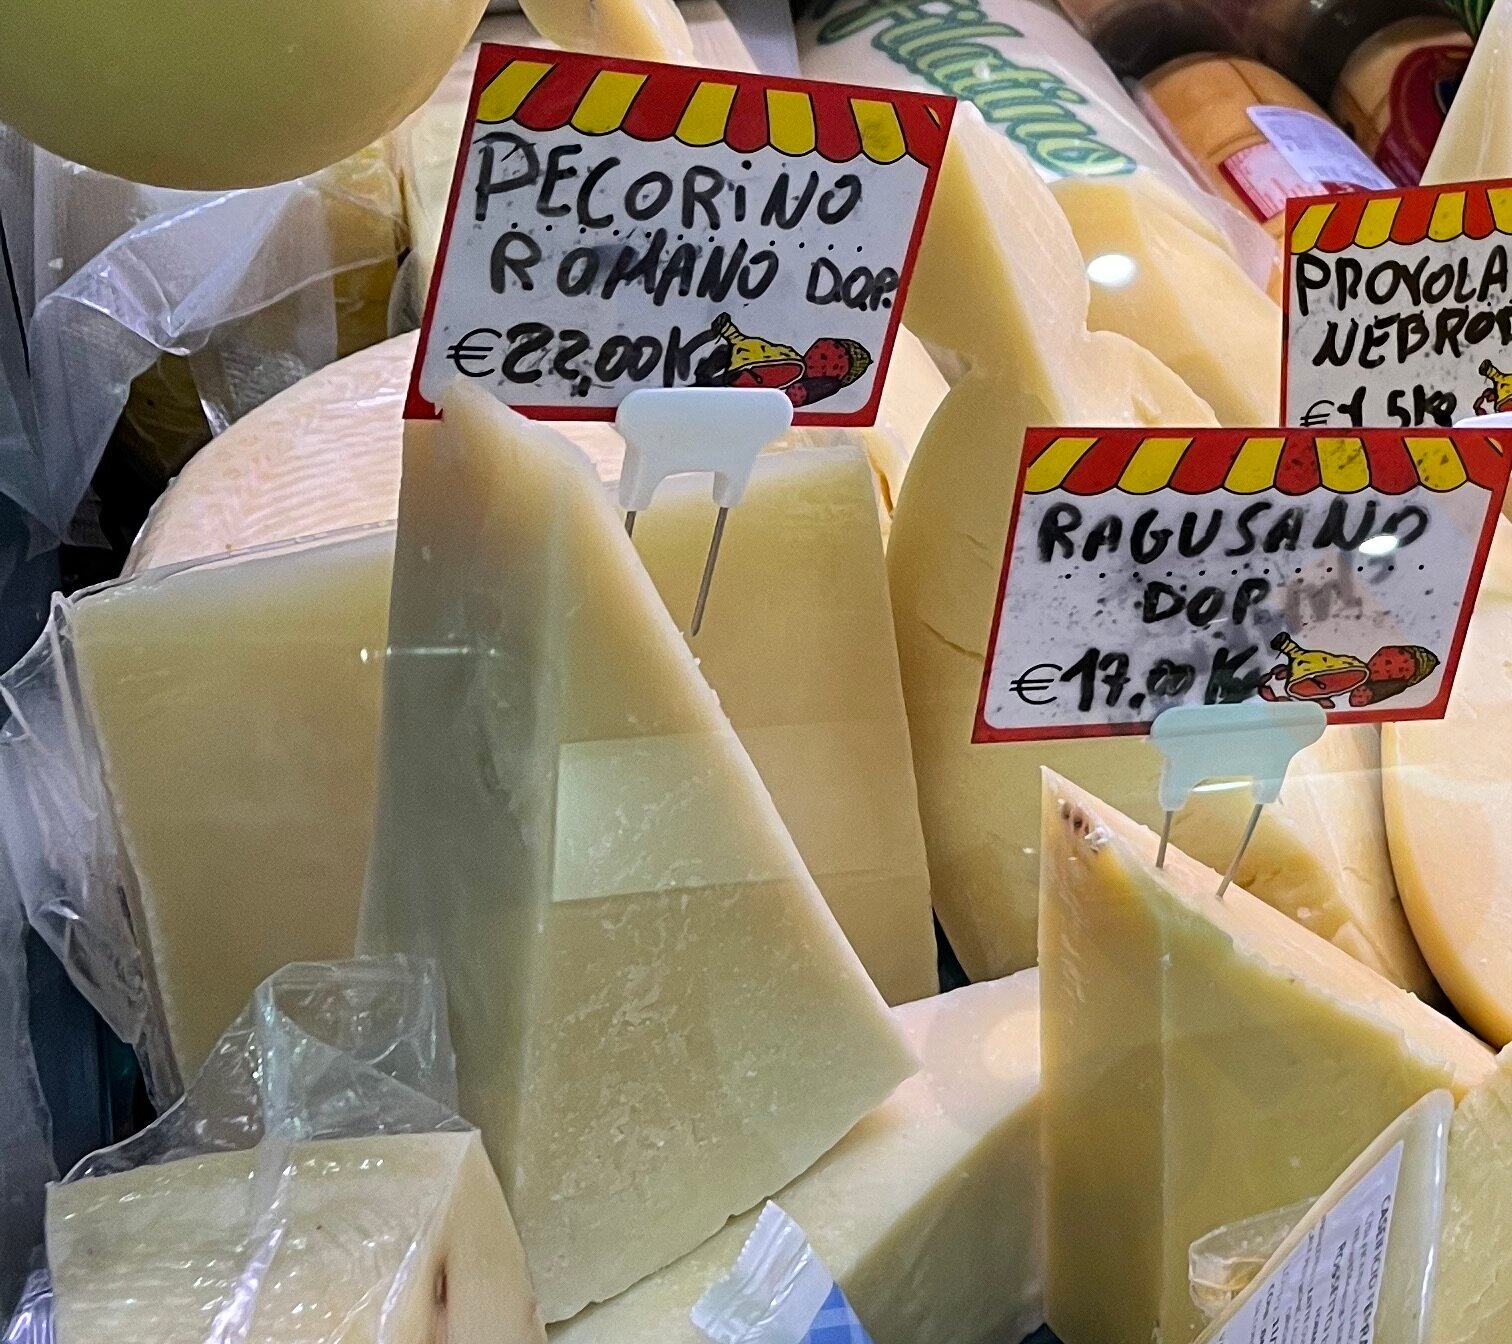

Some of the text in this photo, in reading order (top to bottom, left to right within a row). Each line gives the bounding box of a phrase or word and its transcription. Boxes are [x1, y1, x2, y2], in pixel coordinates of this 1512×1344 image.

[473, 130, 863, 229] PECORINO
[489, 226, 778, 306] ROMANO
[1294, 244, 1508, 317] PROVOLA
[1037, 496, 1431, 565] RAGUSANO
